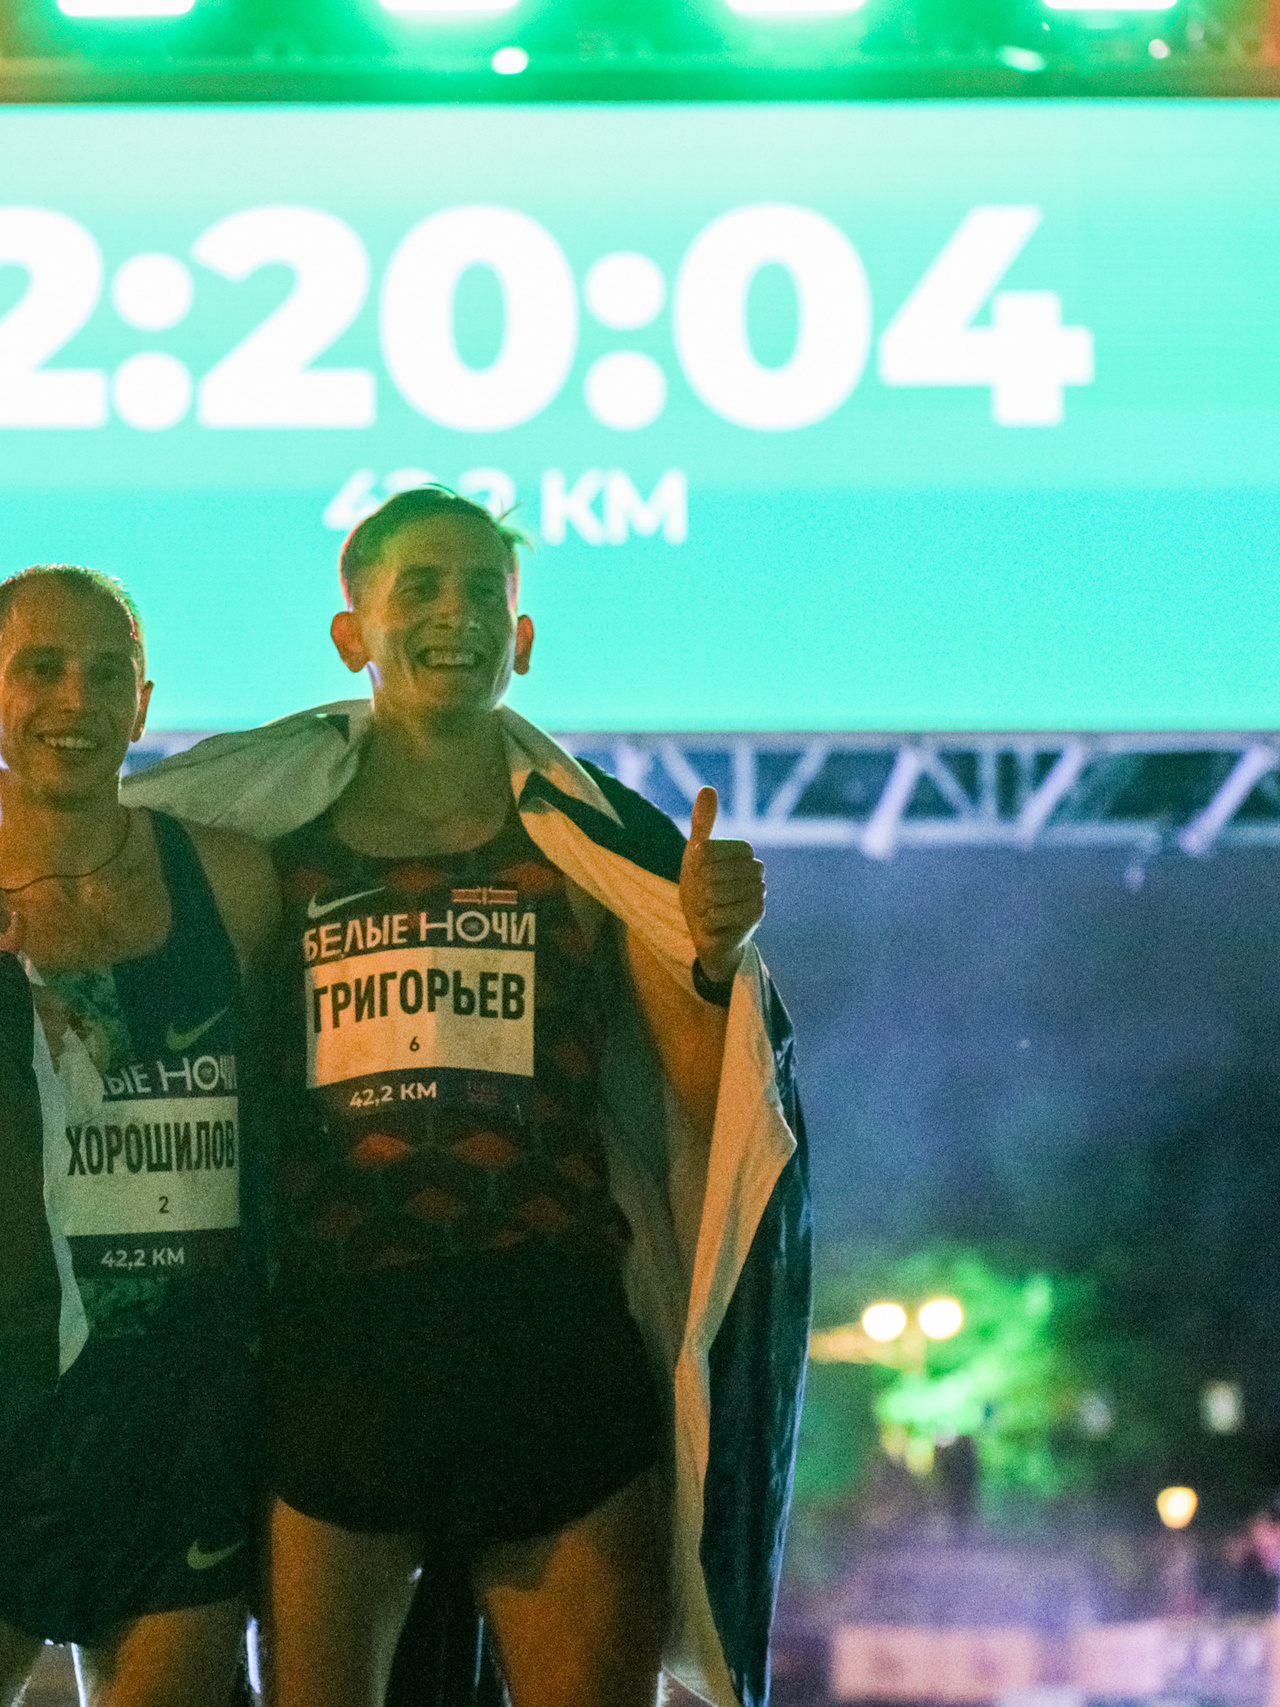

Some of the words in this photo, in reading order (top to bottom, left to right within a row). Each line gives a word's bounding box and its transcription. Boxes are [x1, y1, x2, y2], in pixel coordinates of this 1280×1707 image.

[540, 466, 688, 546] КМ
[303, 913, 409, 963] БЕЛЫЕ
[420, 909, 537, 945] НОЧИ
[312, 968, 526, 1034] ГРИГОРЬЕВ
[409, 1036, 421, 1052] 6
[349, 1085, 394, 1108] 42,2
[400, 1082, 438, 1101] КМ
[66, 1119, 236, 1177] ХОРОШИЛОВ
[158, 1196, 170, 1214] 2
[101, 1249, 147, 1271] 42,2
[152, 1247, 185, 1266] КМ
